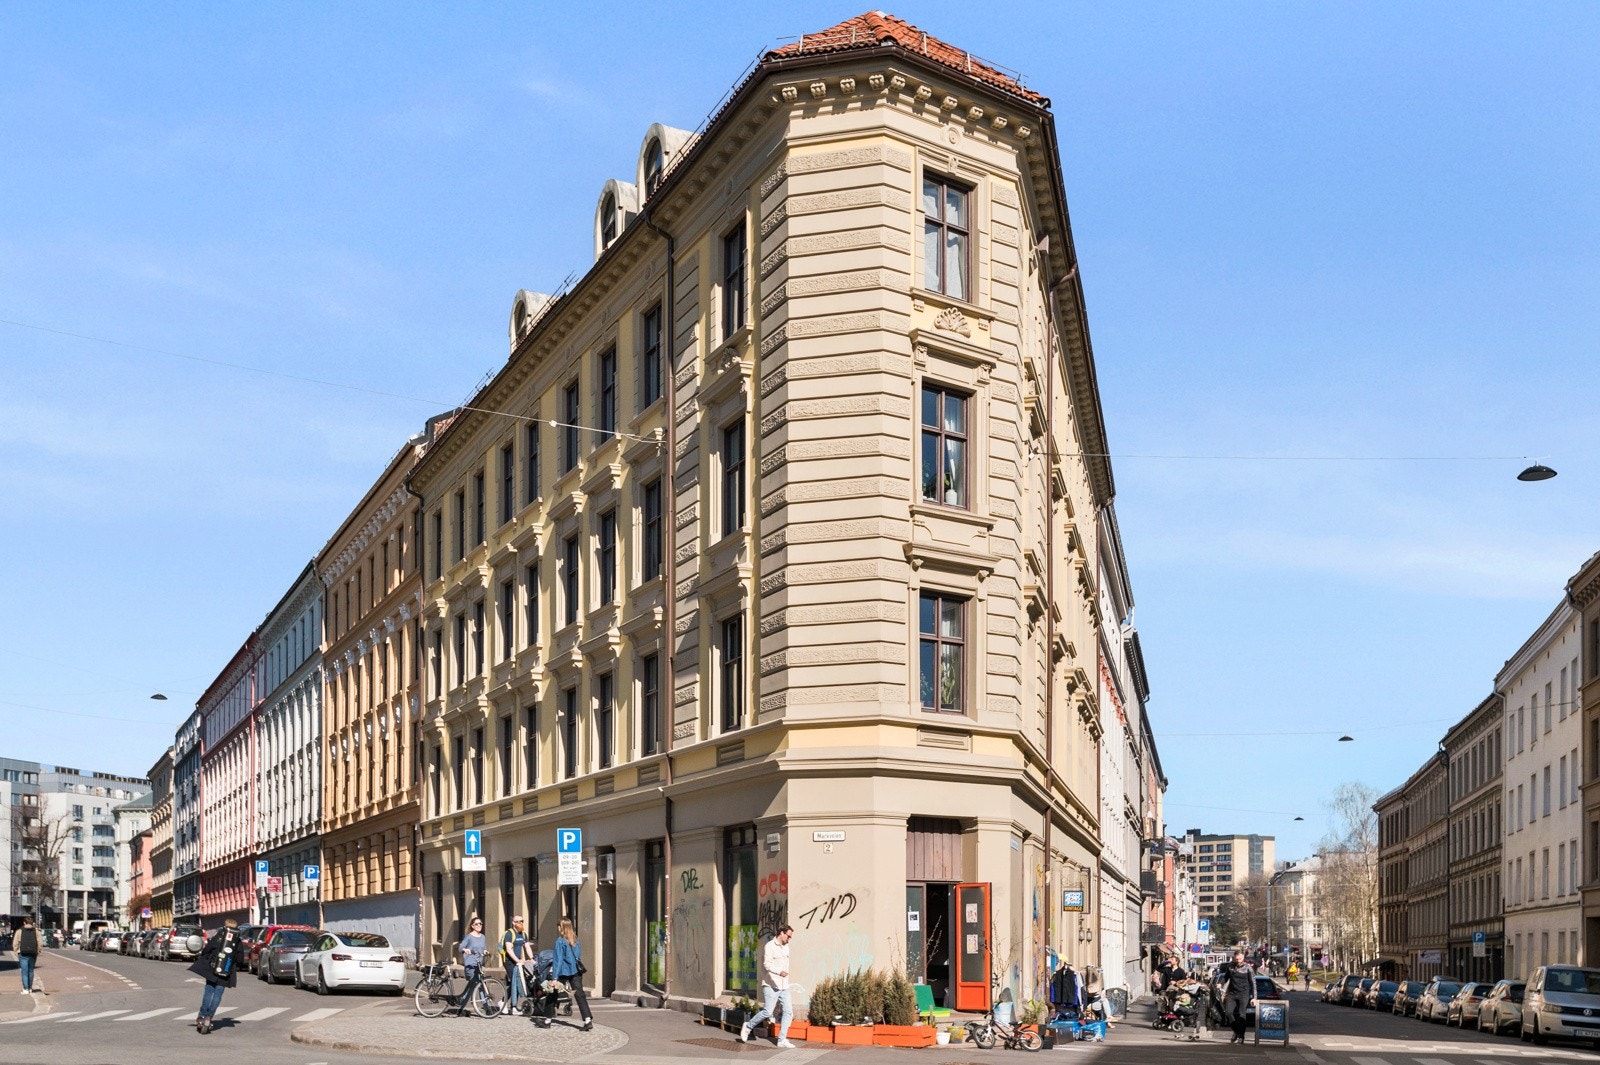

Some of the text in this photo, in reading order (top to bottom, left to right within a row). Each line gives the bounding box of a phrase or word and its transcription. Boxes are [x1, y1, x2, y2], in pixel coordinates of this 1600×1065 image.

[563, 831, 576, 850] P
[825, 843, 831, 852] 2
[258, 862, 266, 871] P
[307, 867, 315, 878] P
[1200, 921, 1207, 930] P
[1475, 932, 1483, 942] P
